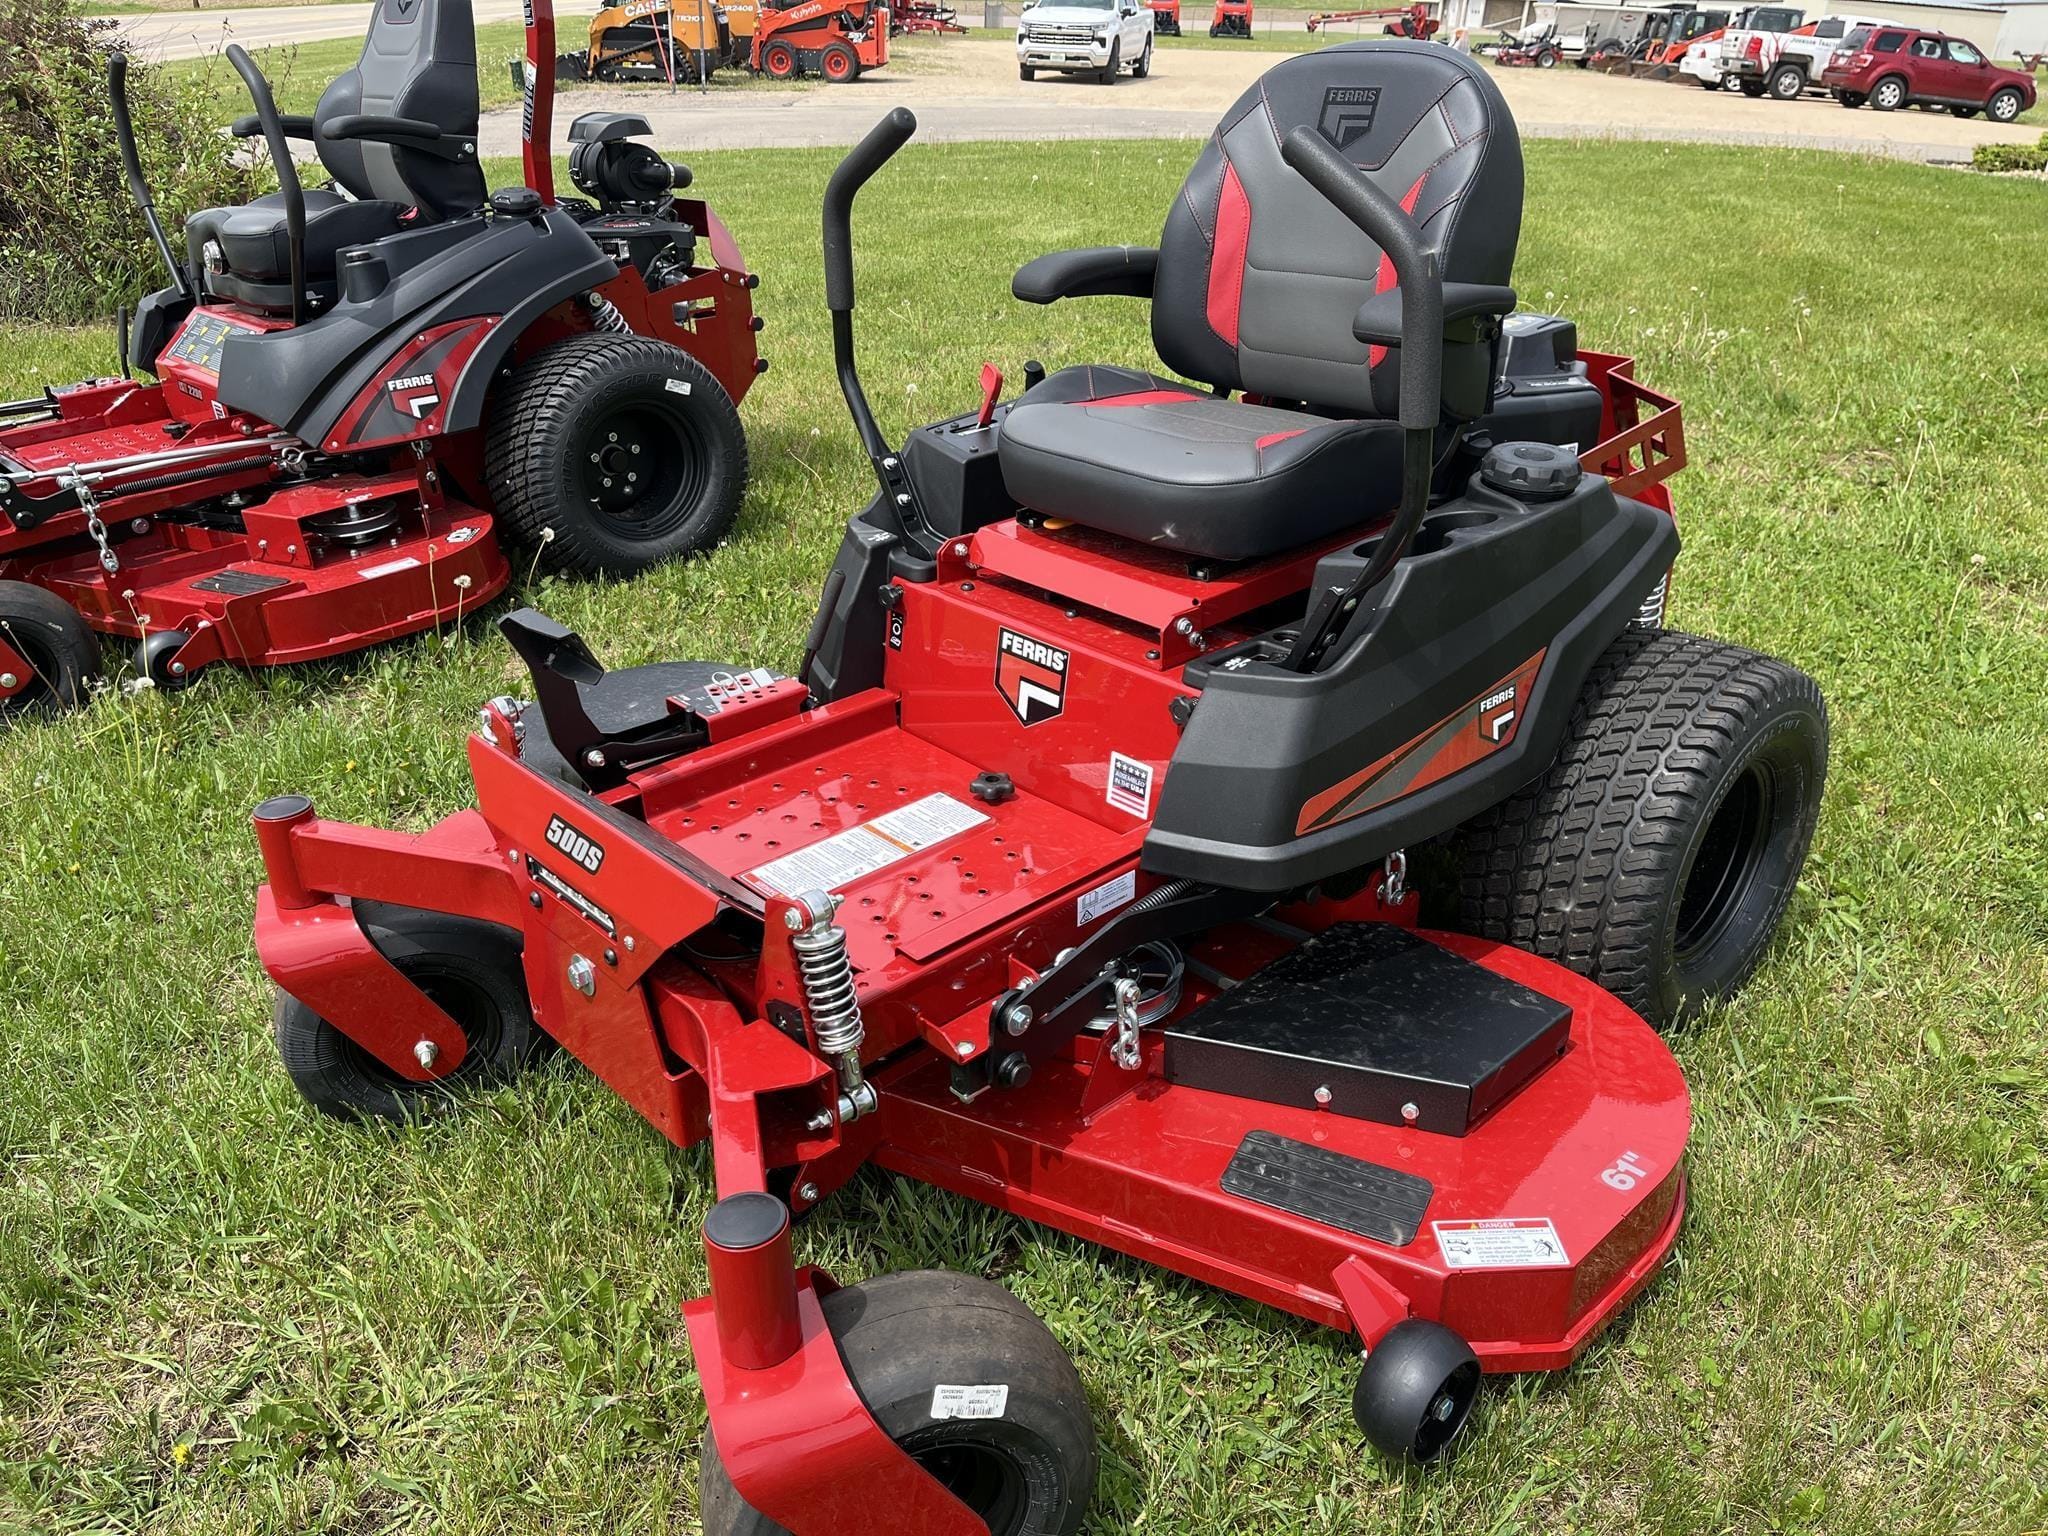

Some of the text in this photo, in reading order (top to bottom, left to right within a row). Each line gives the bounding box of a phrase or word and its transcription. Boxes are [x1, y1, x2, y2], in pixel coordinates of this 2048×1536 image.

[624, 0, 666, 17] CASE
[790, 4, 822, 19] Kubota
[1329, 90, 1377, 102] FERRIS
[387, 374, 433, 391] FERRIS
[1002, 631, 1068, 671] FERRIS
[1480, 686, 1515, 712] FERRIS
[1130, 784, 1144, 794] USA
[546, 818, 603, 871] 500S
[1601, 1151, 1647, 1190] 61"
